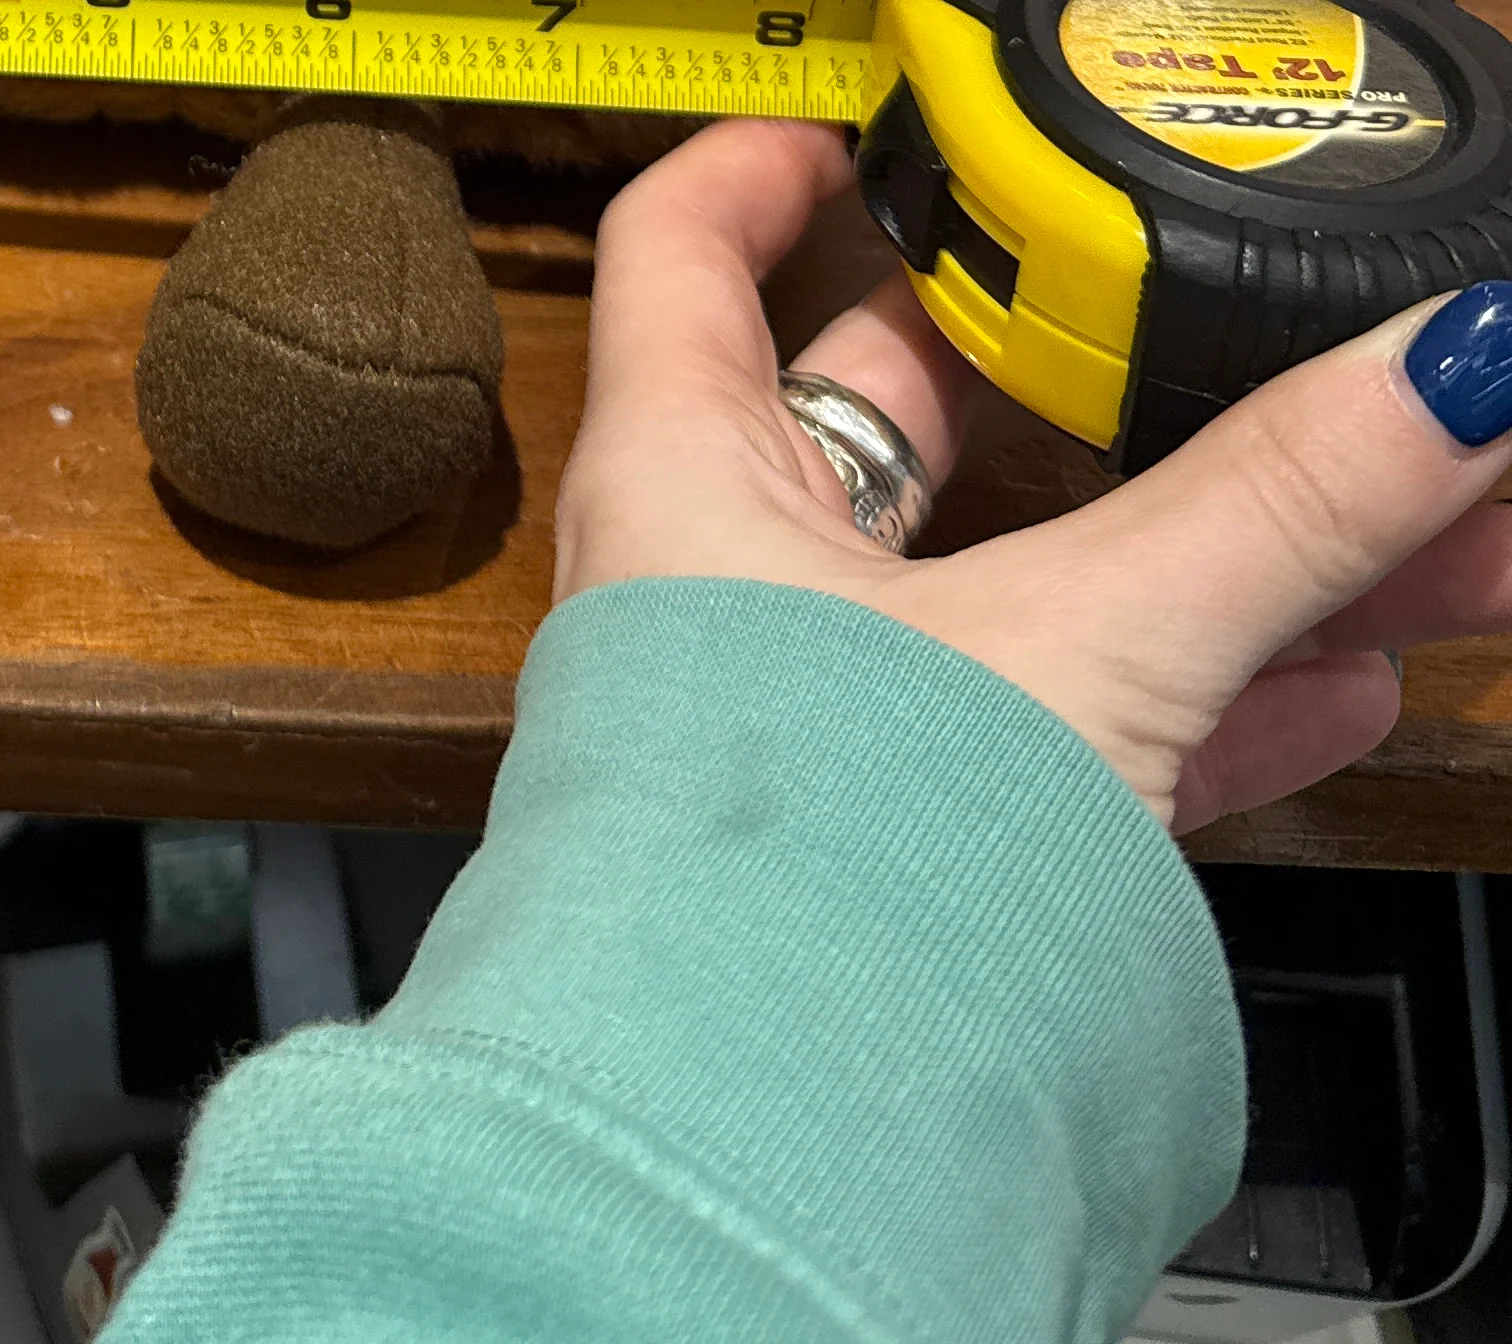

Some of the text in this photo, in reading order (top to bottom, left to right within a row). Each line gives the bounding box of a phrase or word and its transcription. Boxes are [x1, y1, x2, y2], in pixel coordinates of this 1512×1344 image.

[755, 11, 804, 47] 8
[1112, 47, 1258, 79] Tape
[1275, 87, 1354, 100] SERIES
[1361, 90, 1407, 103] PRO
[1146, 102, 1409, 132] G-FORCE
